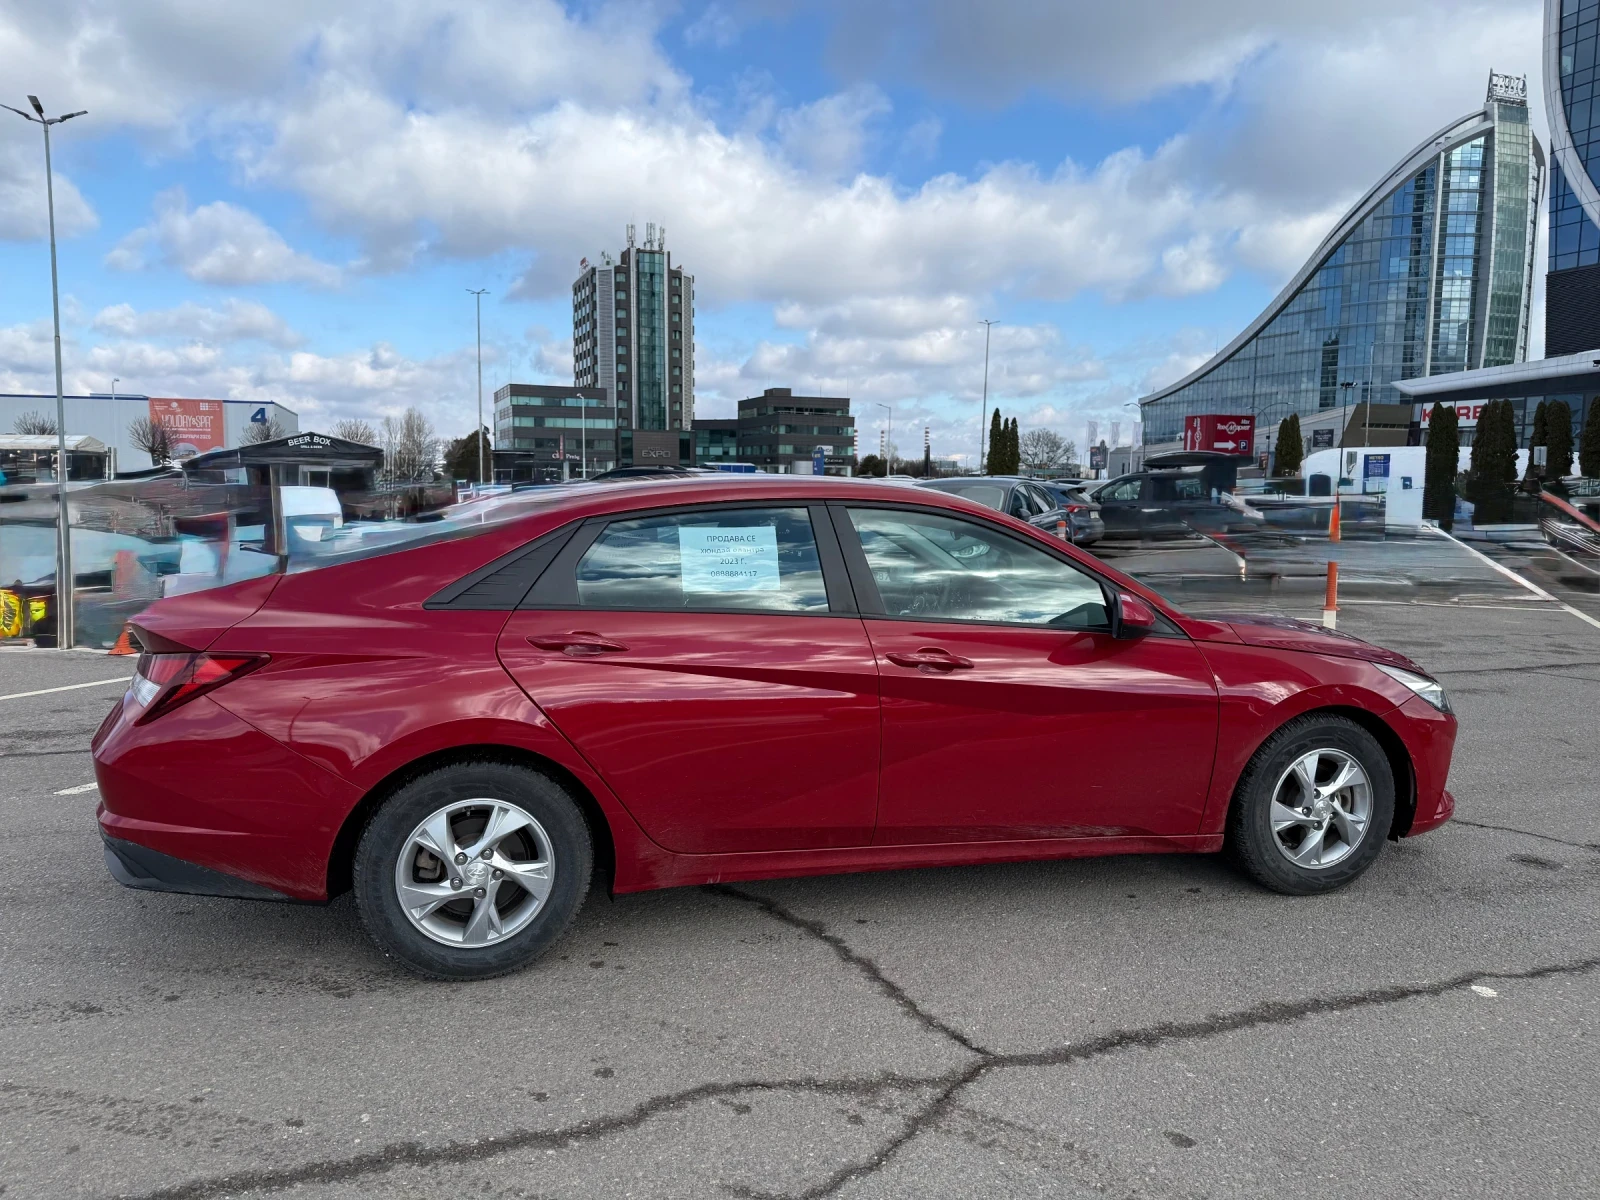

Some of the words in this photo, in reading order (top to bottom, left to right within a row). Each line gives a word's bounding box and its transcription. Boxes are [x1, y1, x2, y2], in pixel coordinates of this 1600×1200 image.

[251, 407, 267, 426] 4
[1422, 405, 1483, 422] KRE
[287, 435, 311, 447] BEER
[313, 435, 332, 446] BOX
[642, 449, 671, 458] EXPO
[706, 535, 745, 543] ПРОДАВА
[746, 535, 756, 543] СЕ
[720, 557, 738, 565] 2023
